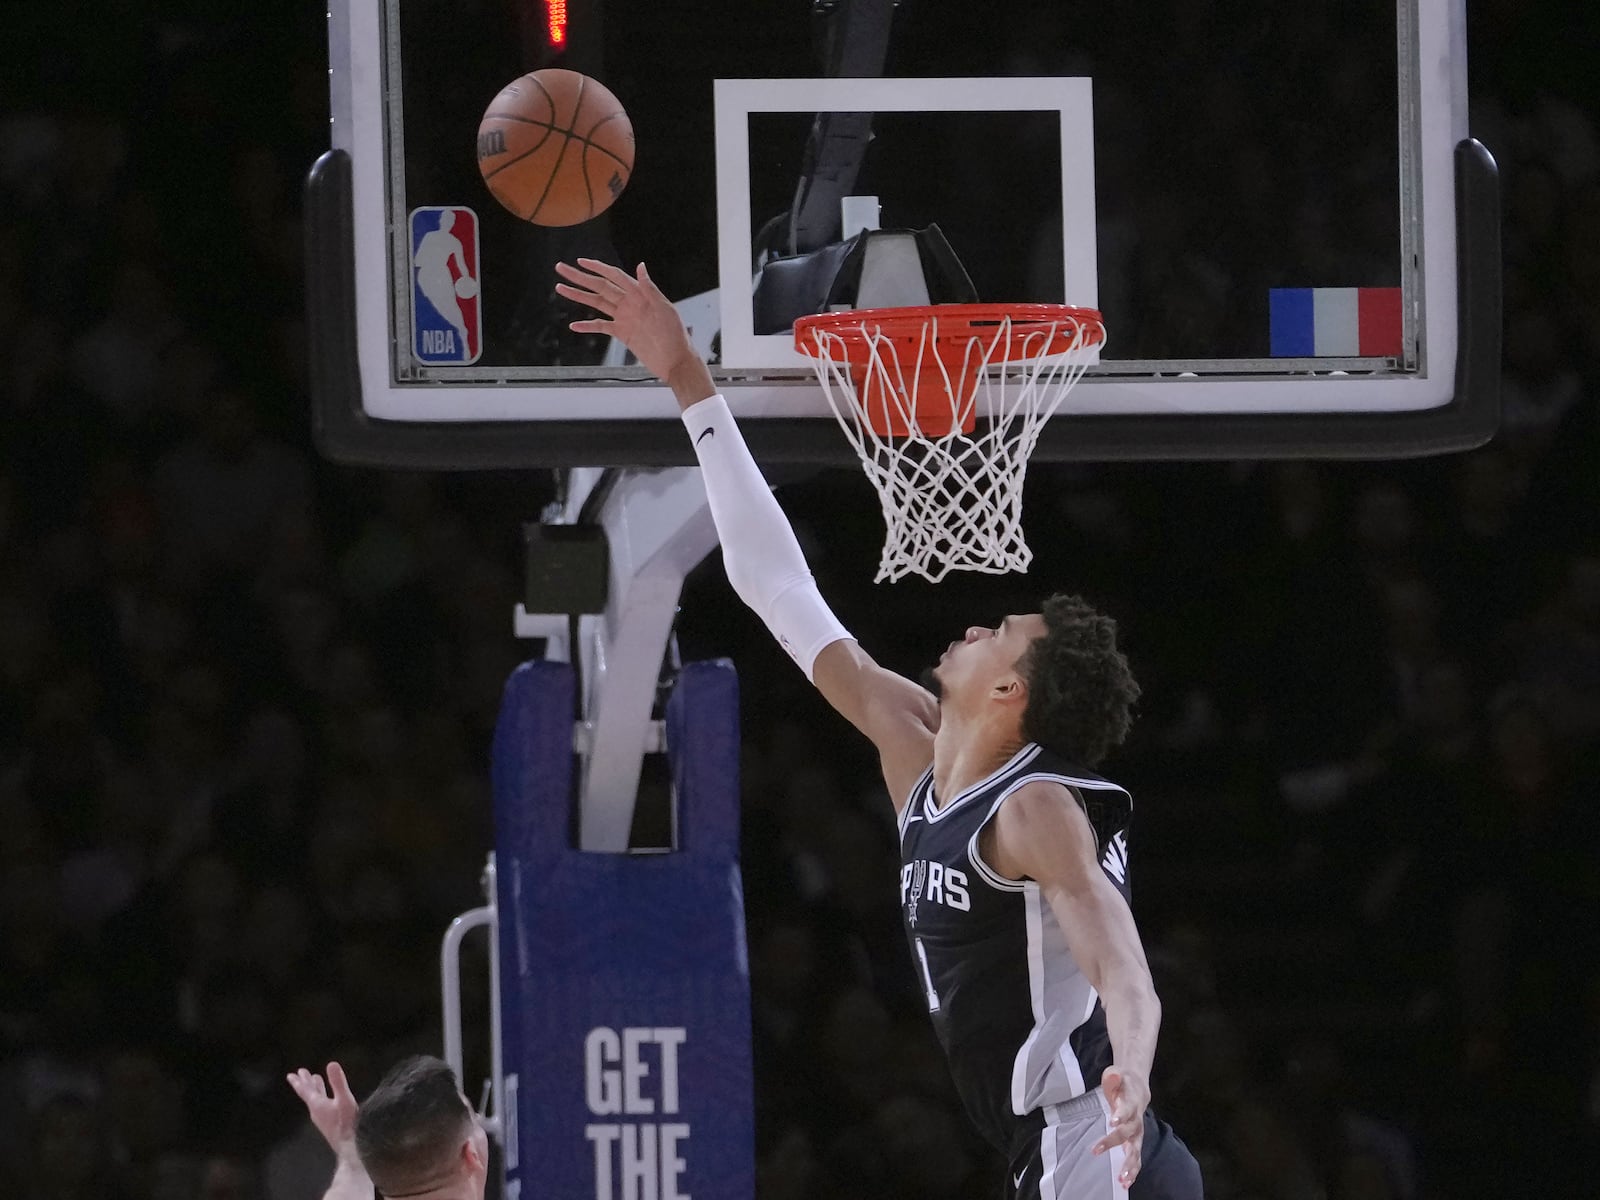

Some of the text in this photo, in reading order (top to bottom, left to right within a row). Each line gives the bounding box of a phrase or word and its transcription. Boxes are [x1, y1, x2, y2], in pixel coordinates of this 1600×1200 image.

[422, 329, 456, 354] NBA
[900, 859, 971, 924] PURS
[584, 1026, 687, 1115] GET
